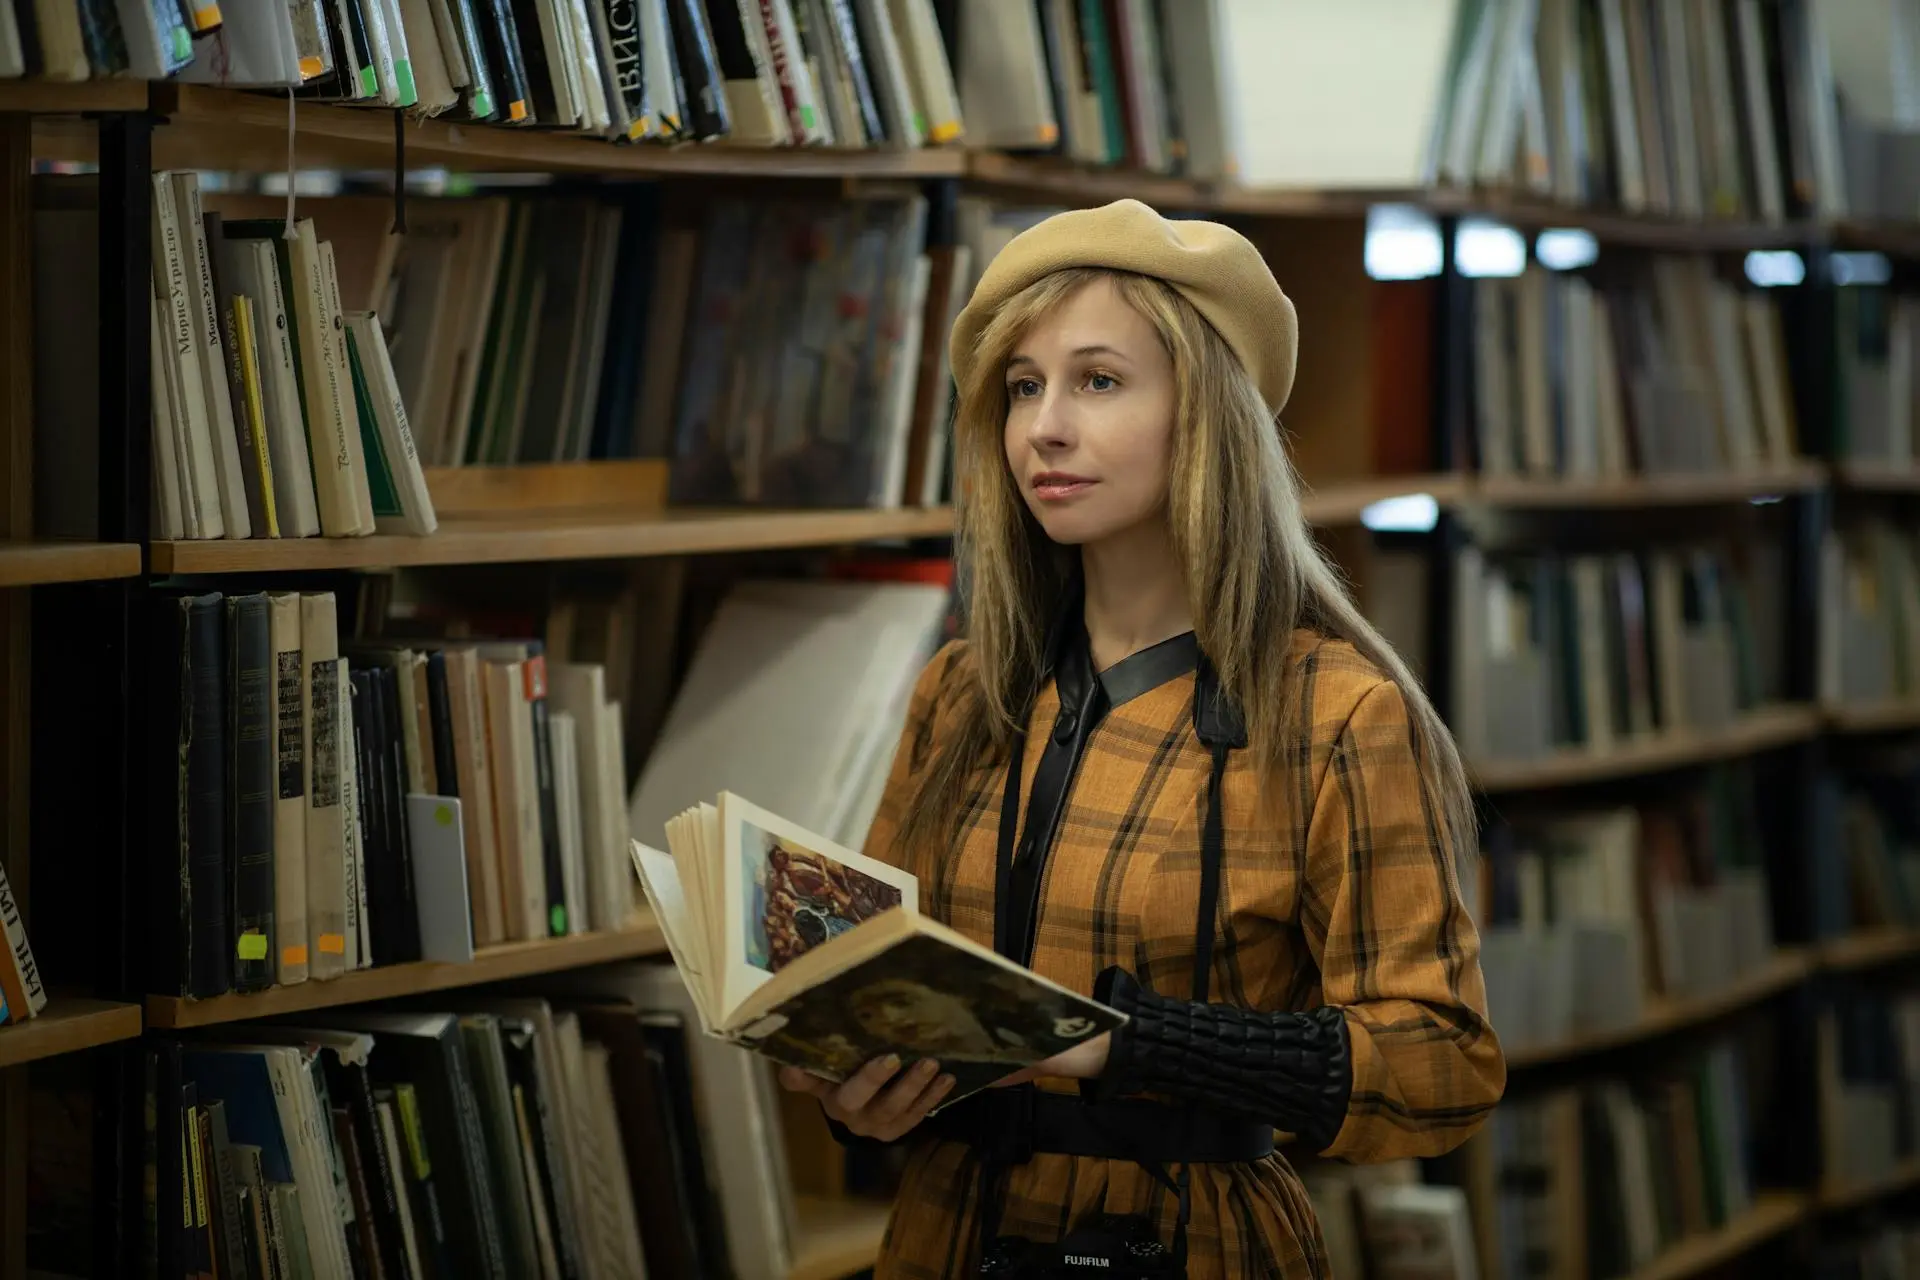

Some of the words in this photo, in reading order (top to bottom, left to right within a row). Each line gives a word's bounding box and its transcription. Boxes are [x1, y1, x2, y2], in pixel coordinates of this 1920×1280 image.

[174, 298, 192, 355] Морис
[206, 297, 218, 346] Морис
[15, 928, 42, 998] ГАНС
[1063, 1254, 1110, 1268] FUJIFILM
